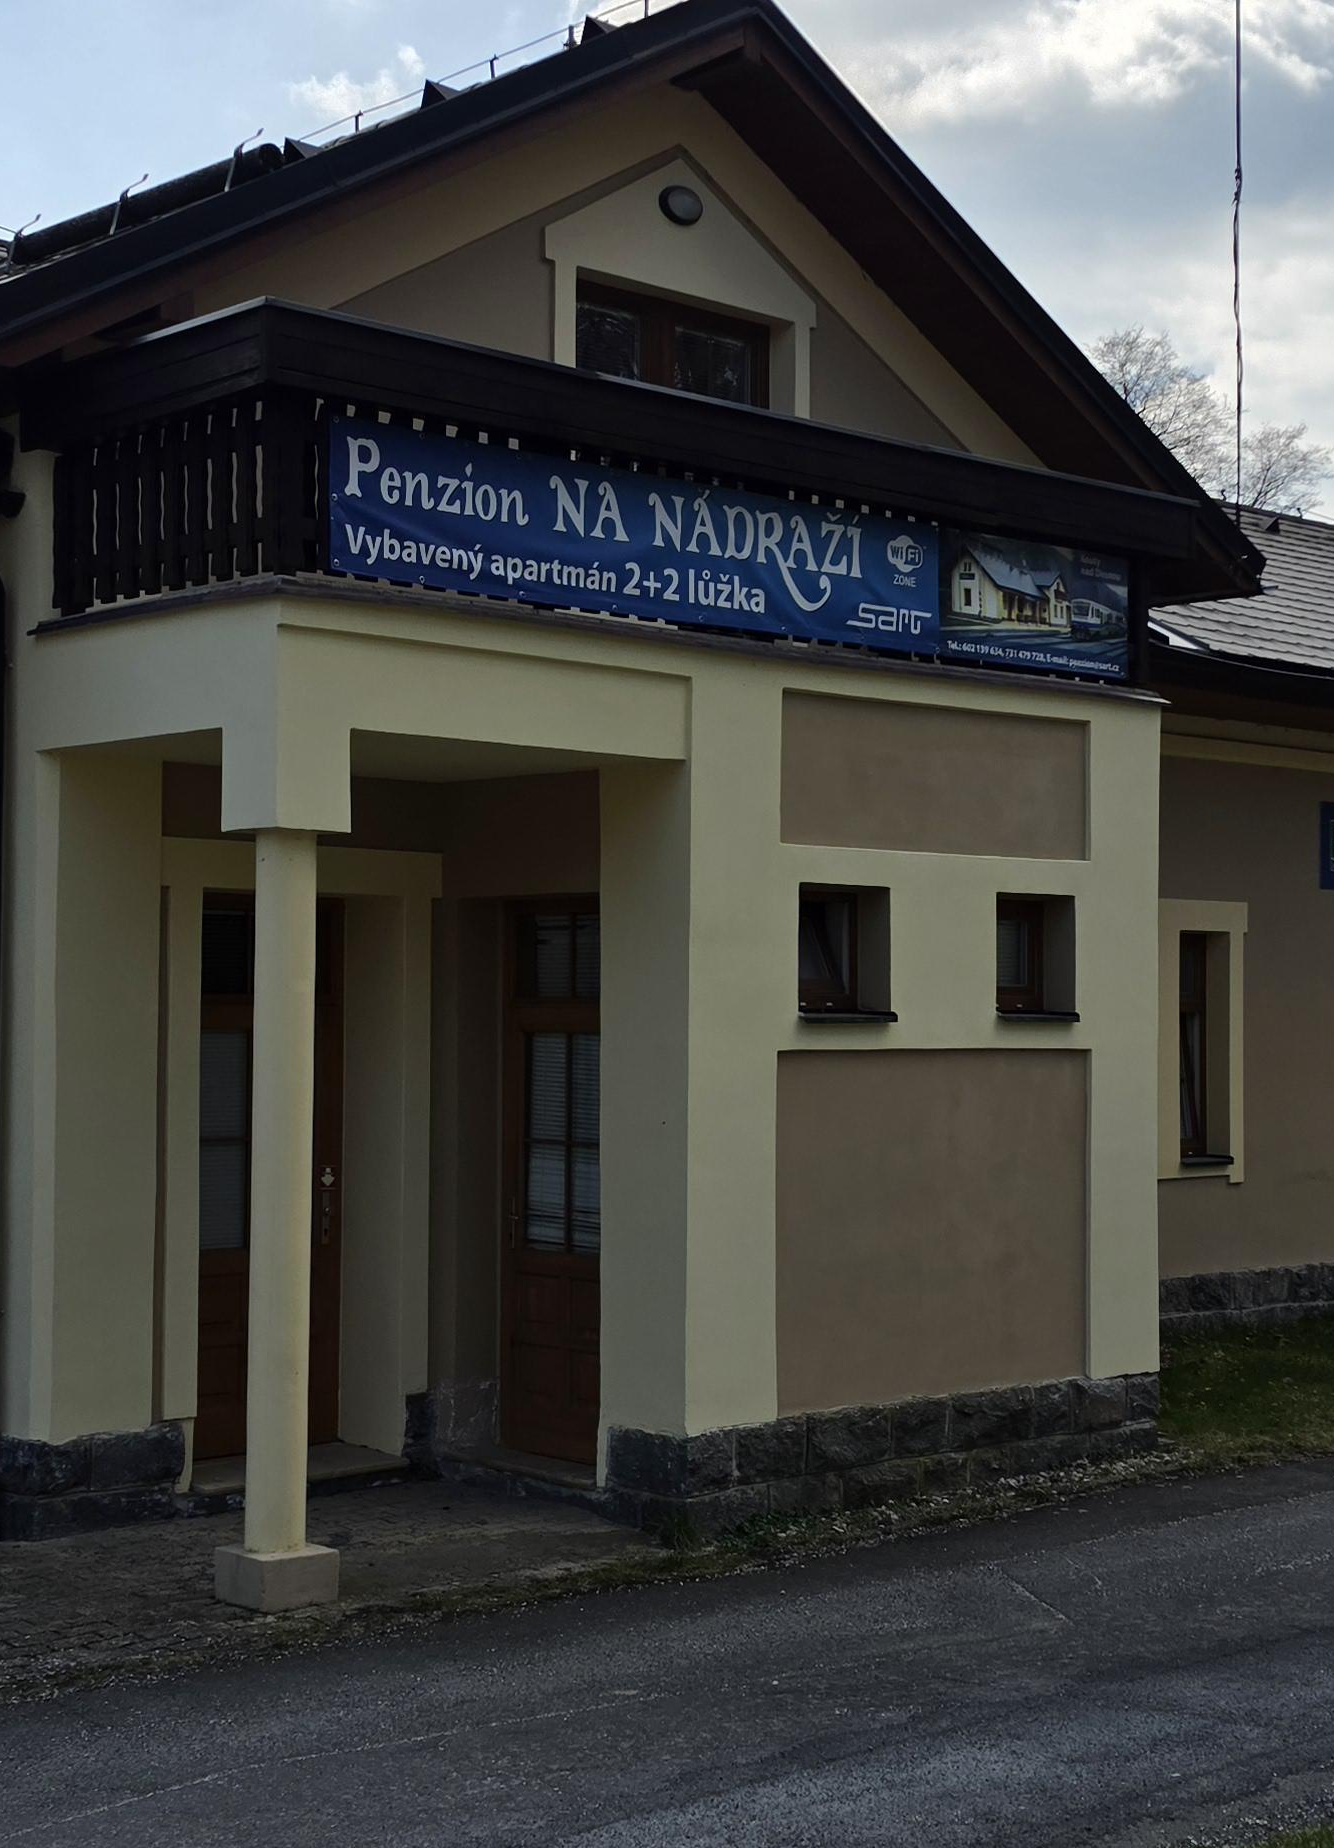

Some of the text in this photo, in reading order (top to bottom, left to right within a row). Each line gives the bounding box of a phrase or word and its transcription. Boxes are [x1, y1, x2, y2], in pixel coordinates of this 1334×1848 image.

[343, 435, 863, 612] Penzion NA NÁDRAŽÍ
[343, 523, 766, 615] Vybavený apartmán 2+2 lůžka
[892, 573, 918, 589] ZONE
